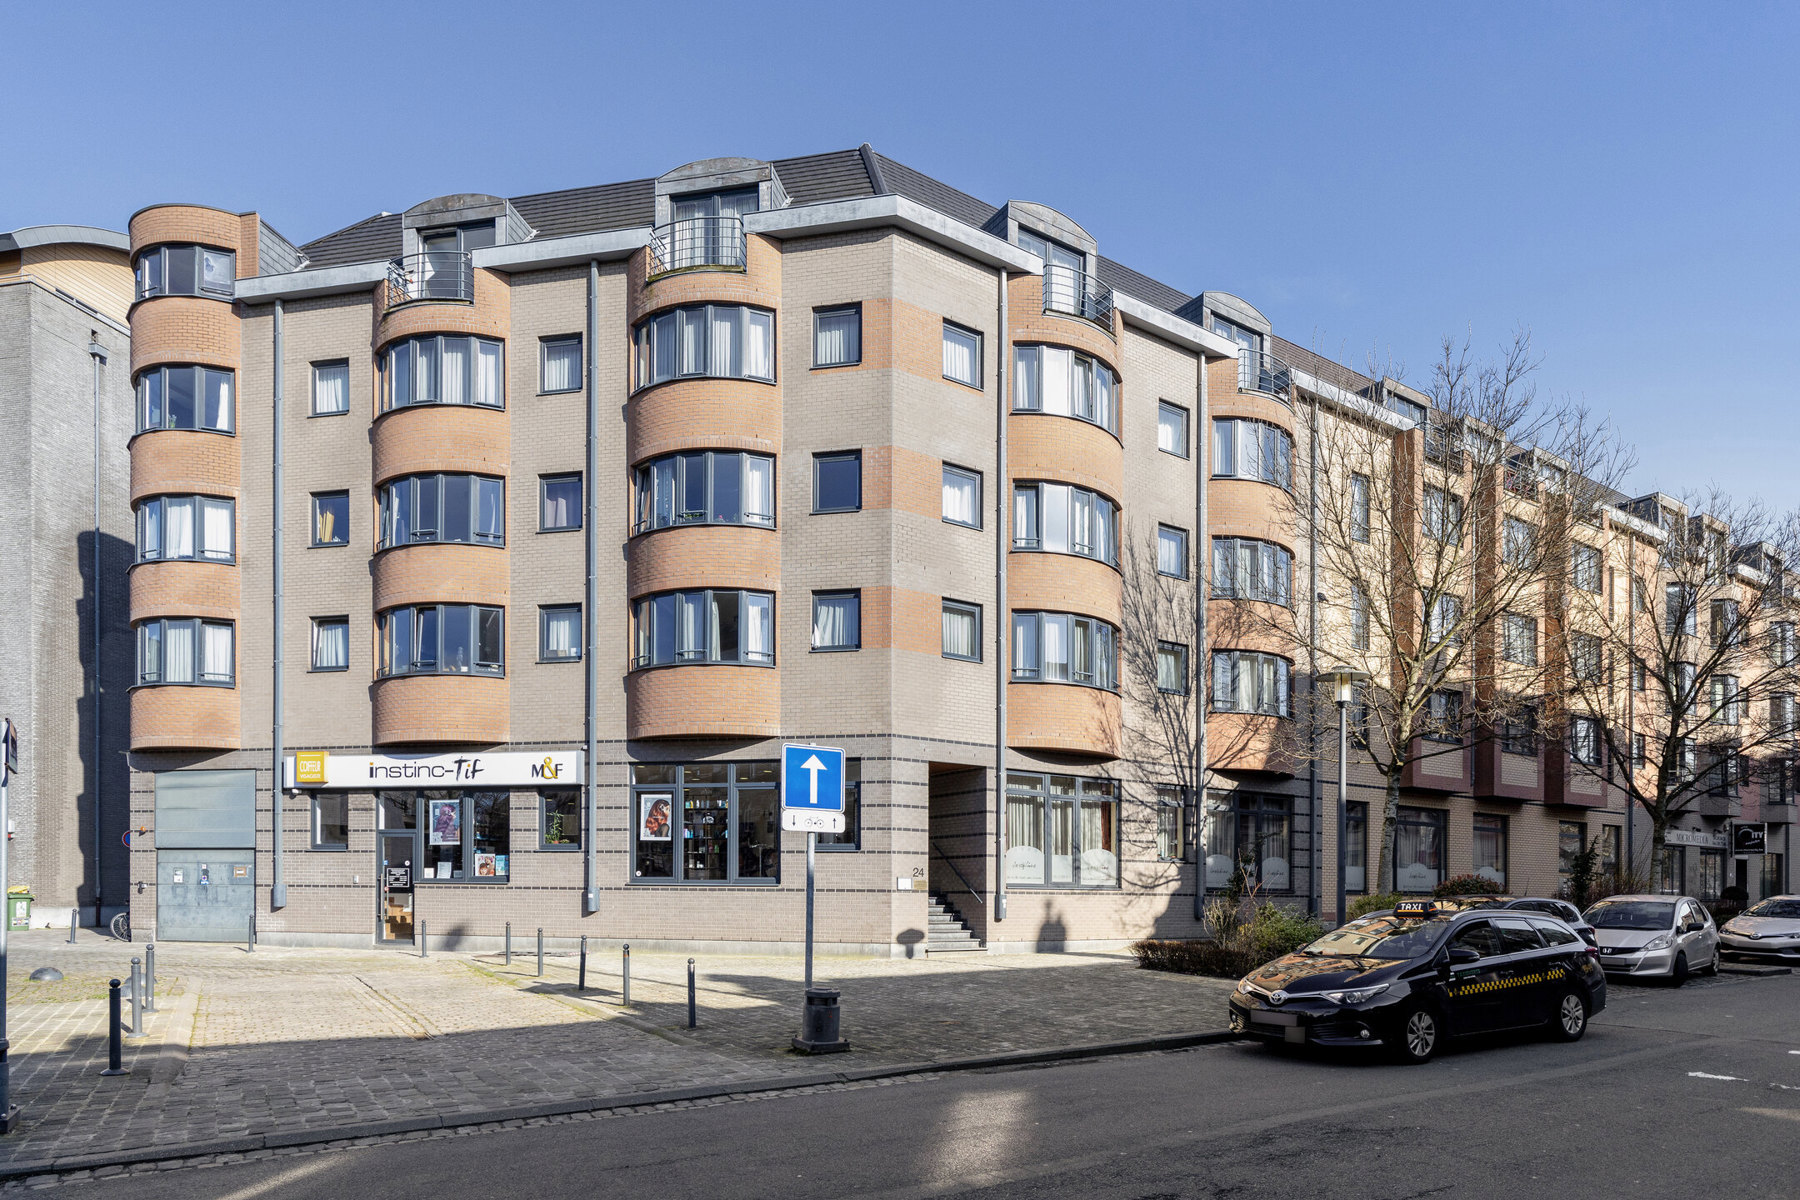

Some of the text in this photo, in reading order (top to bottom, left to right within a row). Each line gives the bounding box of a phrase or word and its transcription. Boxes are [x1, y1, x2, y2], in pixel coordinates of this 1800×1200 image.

[299, 761, 321, 772] COIFFEUR
[531, 756, 563, 779] M&F
[912, 867, 924, 877] 24
